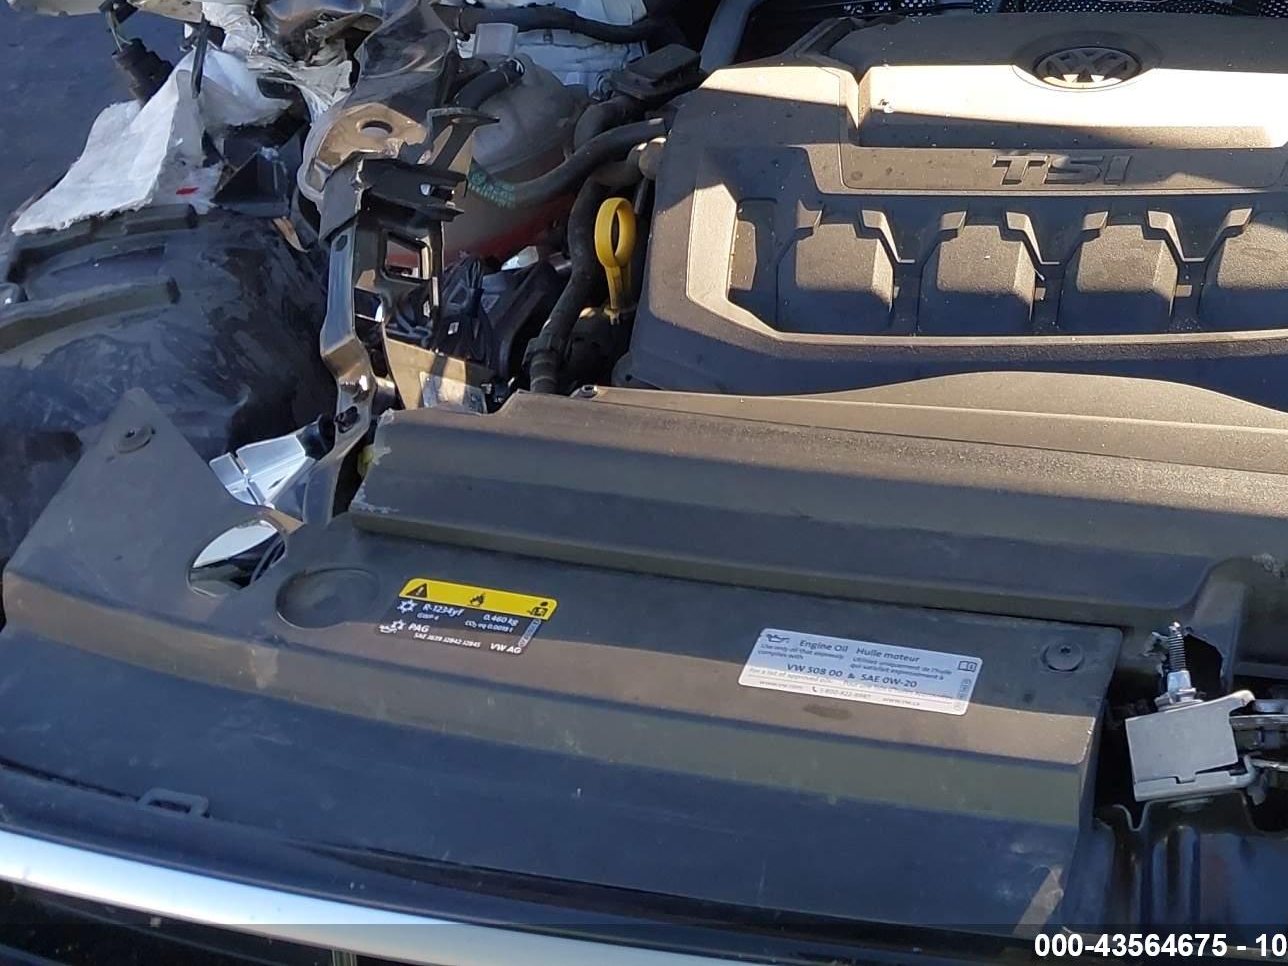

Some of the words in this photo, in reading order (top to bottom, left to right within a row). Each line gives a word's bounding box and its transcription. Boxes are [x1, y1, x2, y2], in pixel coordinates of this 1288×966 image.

[992, 154, 1133, 186] TSI
[422, 604, 465, 617] R-1234yf
[484, 614, 507, 625] 0.460
[508, 616, 519, 627] kg
[408, 623, 430, 633] PAG
[490, 643, 506, 653] VW
[507, 645, 523, 654] AG
[800, 640, 833, 651] Engine
[834, 644, 849, 652] Oil
[856, 646, 882, 659] Huile
[883, 652, 921, 663] moteur
[787, 663, 806, 672] VW
[807, 666, 827, 675] 508
[829, 669, 843, 677] 00
[860, 673, 881, 683] SAE
[882, 677, 918, 688] 0W-20
